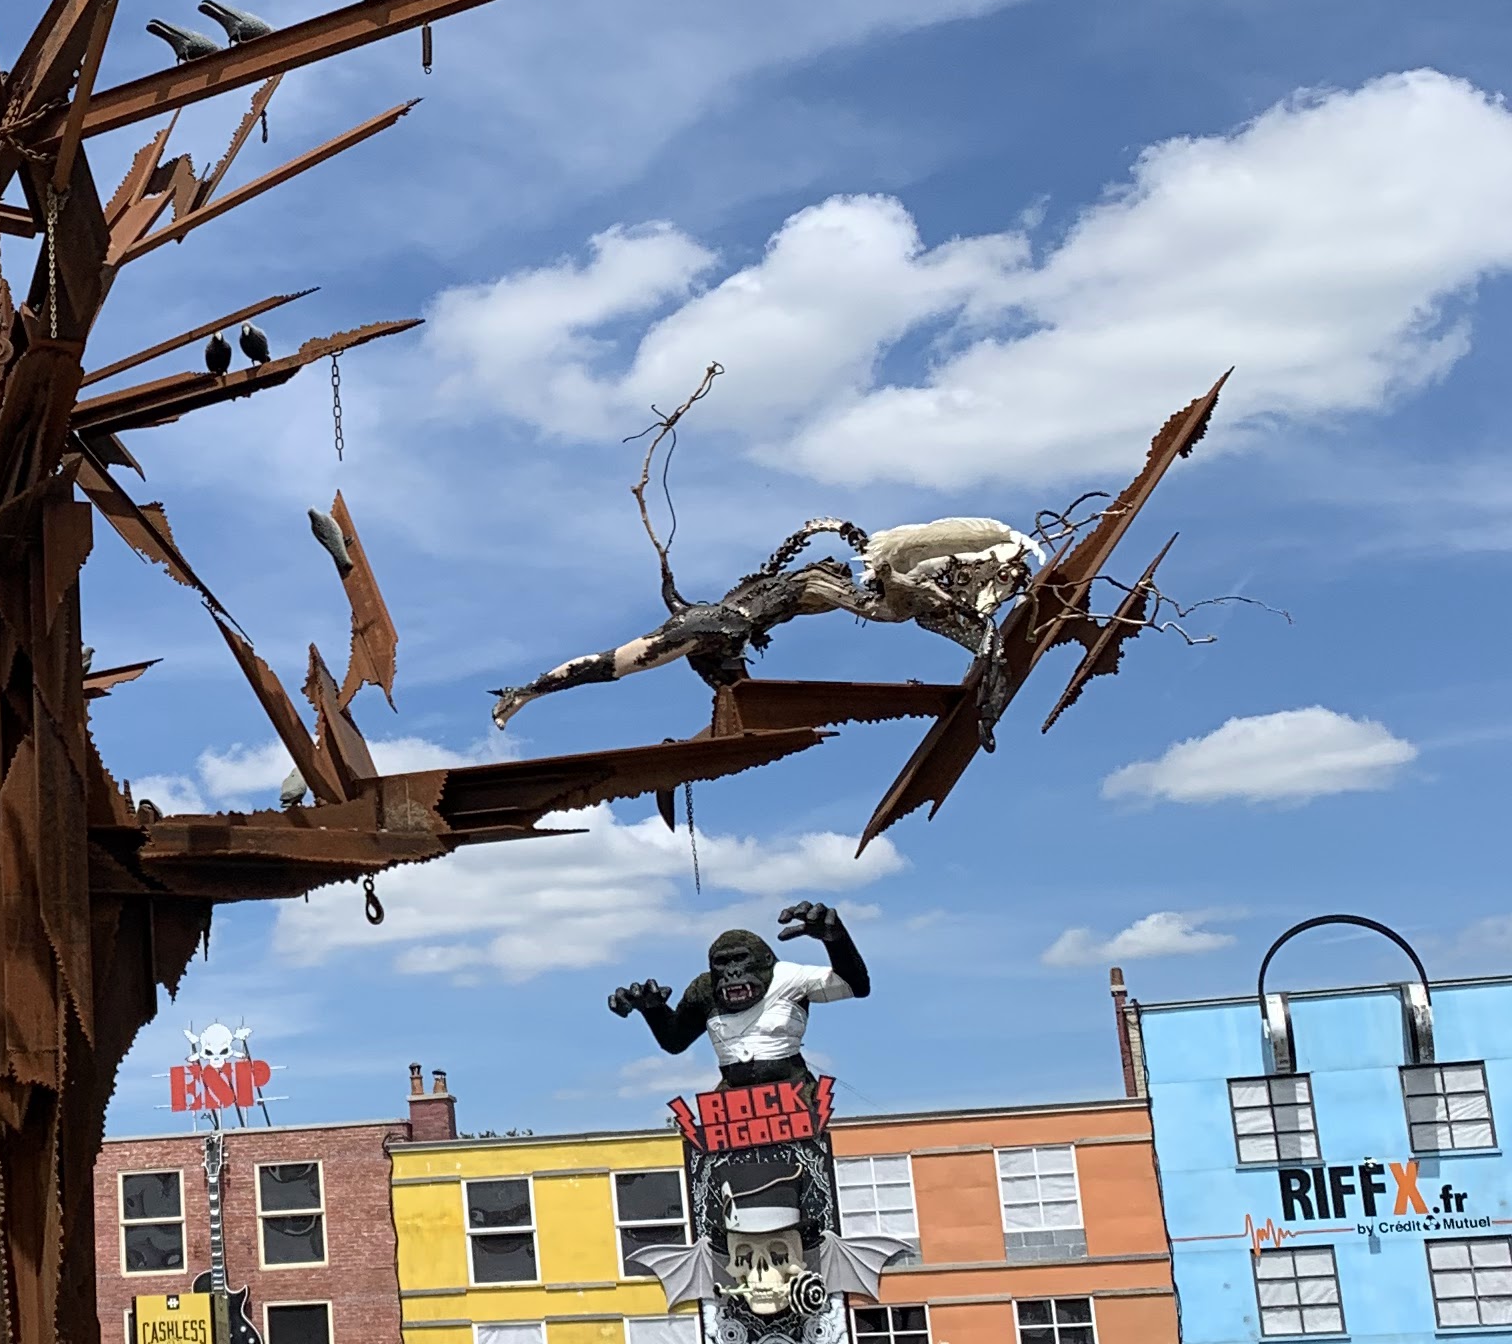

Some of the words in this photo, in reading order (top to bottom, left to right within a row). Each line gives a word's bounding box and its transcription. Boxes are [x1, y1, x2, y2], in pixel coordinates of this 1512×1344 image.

[170, 1060, 271, 1112] ESP
[697, 1081, 809, 1125] ROCK
[704, 1111, 814, 1152] AGOGO
[1357, 1223, 1374, 1236] by
[1378, 1220, 1421, 1234] Crédit
[1443, 1216, 1491, 1230] Mutuel
